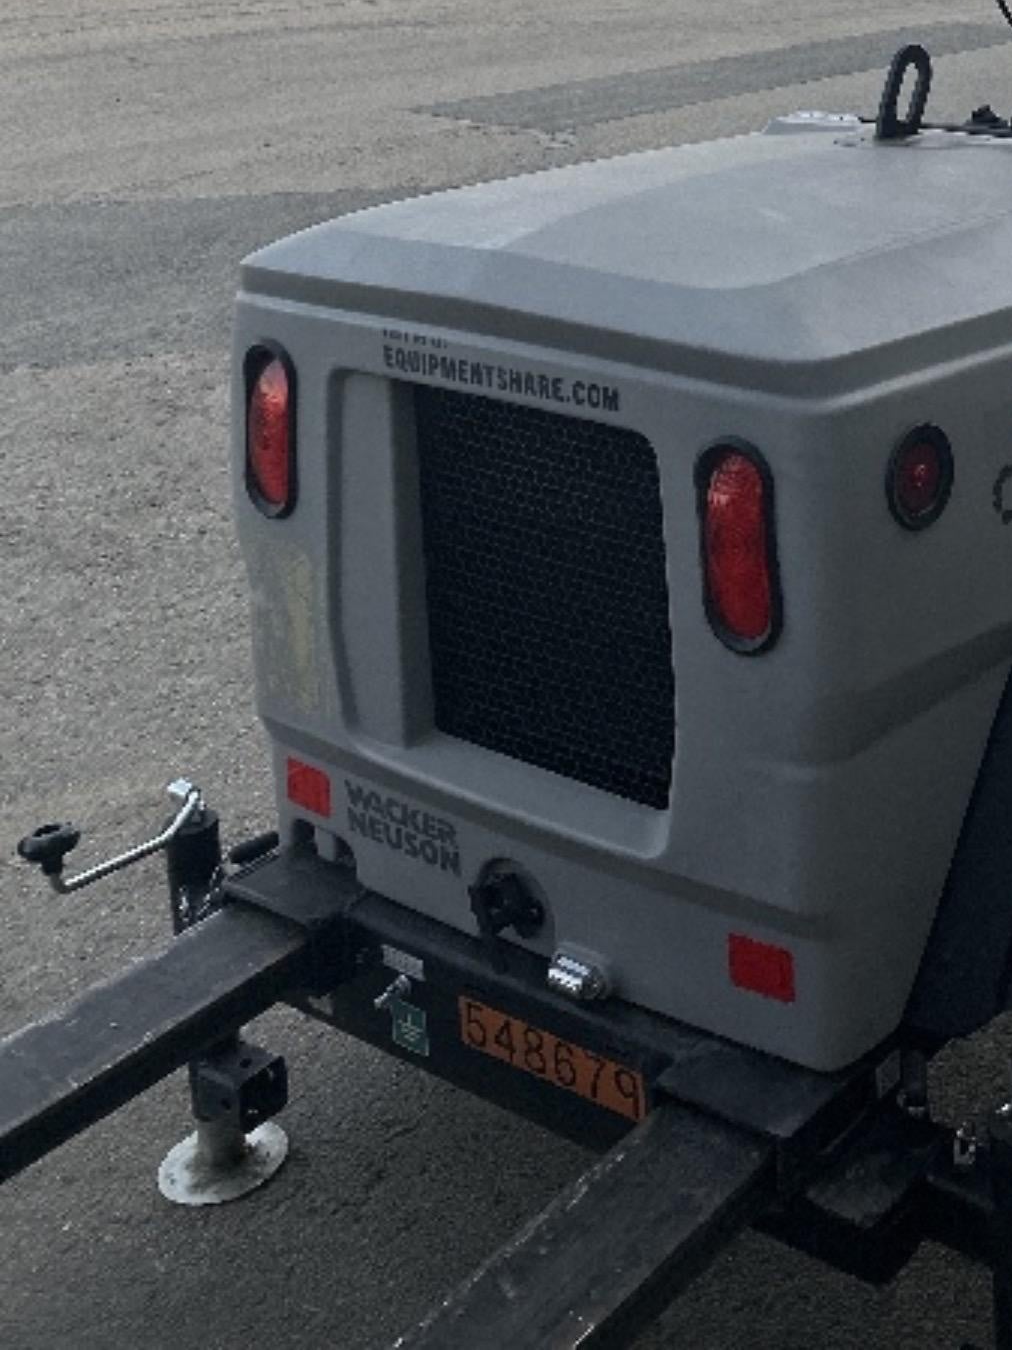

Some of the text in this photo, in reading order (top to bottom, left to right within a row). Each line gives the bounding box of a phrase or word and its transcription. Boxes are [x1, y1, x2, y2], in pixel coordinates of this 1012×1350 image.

[383, 345, 621, 412] EQUIPMENTSHARE.COM
[344, 778, 457, 846] WACKER
[347, 806, 462, 878] NEUSON
[466, 1001, 644, 1120] 548679
